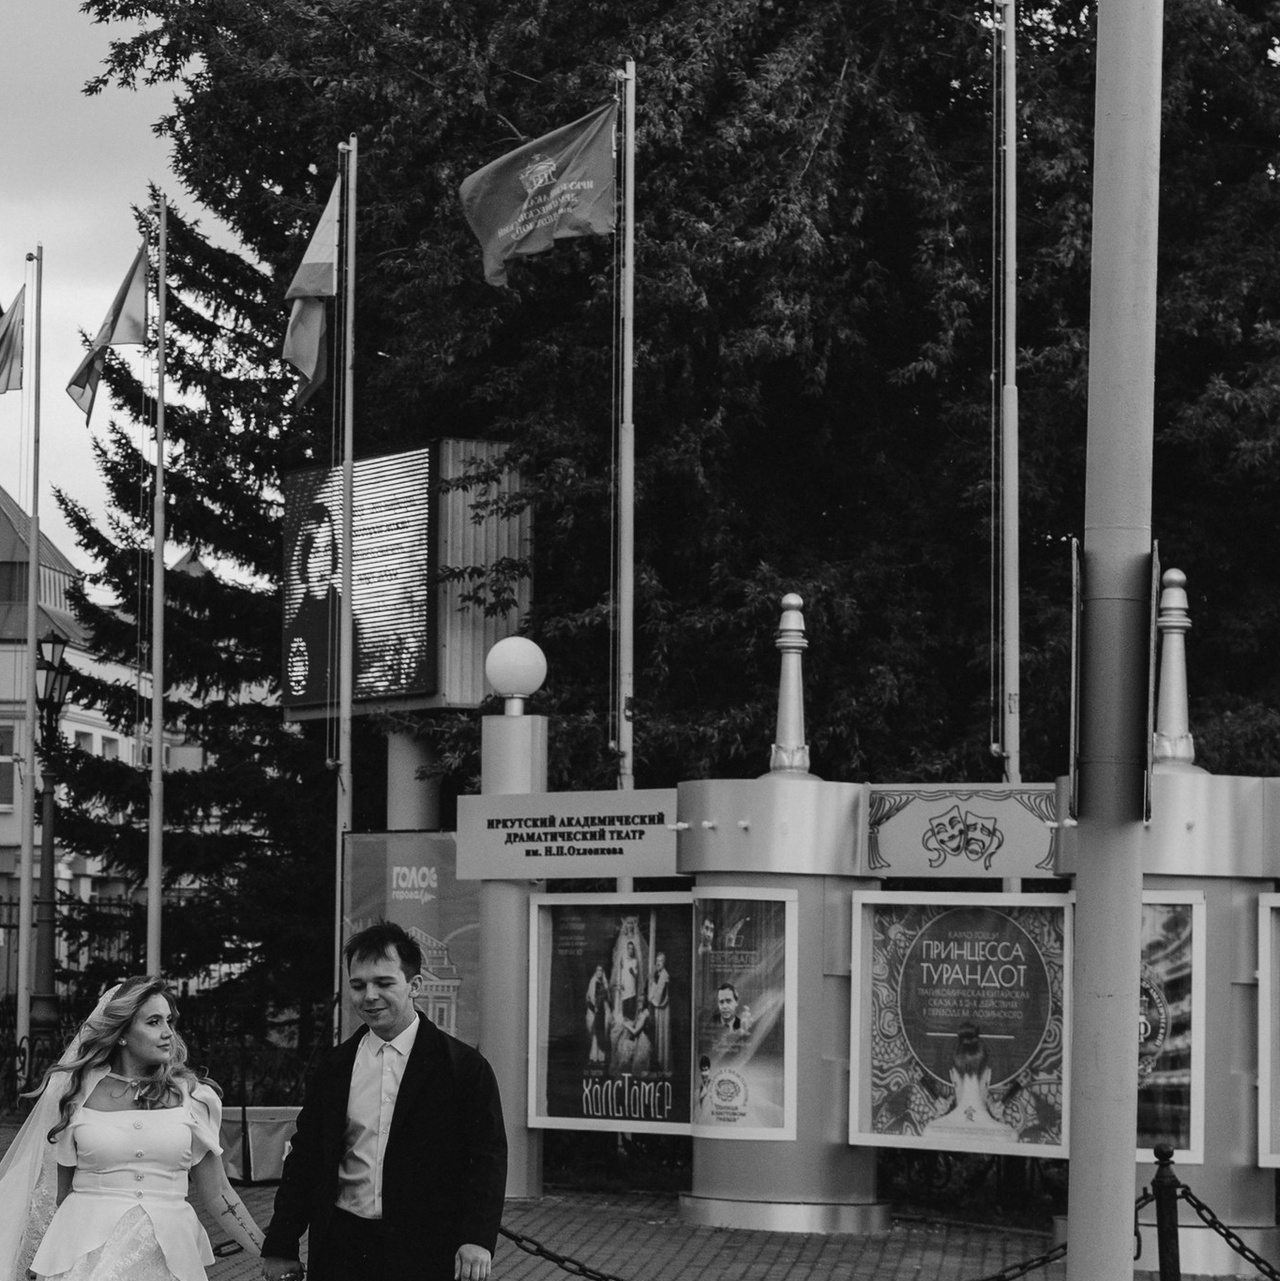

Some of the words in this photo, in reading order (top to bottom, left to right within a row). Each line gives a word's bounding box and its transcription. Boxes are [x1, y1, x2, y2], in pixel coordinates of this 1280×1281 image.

[487, 815, 557, 829] ИРКУТСКИЙ
[559, 812, 665, 827] АКАДЕМИЧЕСКИЙ
[504, 829, 606, 844] ДРАМАТИЧЕСКИЙ
[609, 830, 645, 841] ТЕАТР
[525, 847, 543, 857] им.
[392, 866, 438, 889] ГОЛОС
[922, 940, 1025, 962] ПРИНЦЕССА
[920, 963, 1028, 988] ТУРАНДОТ
